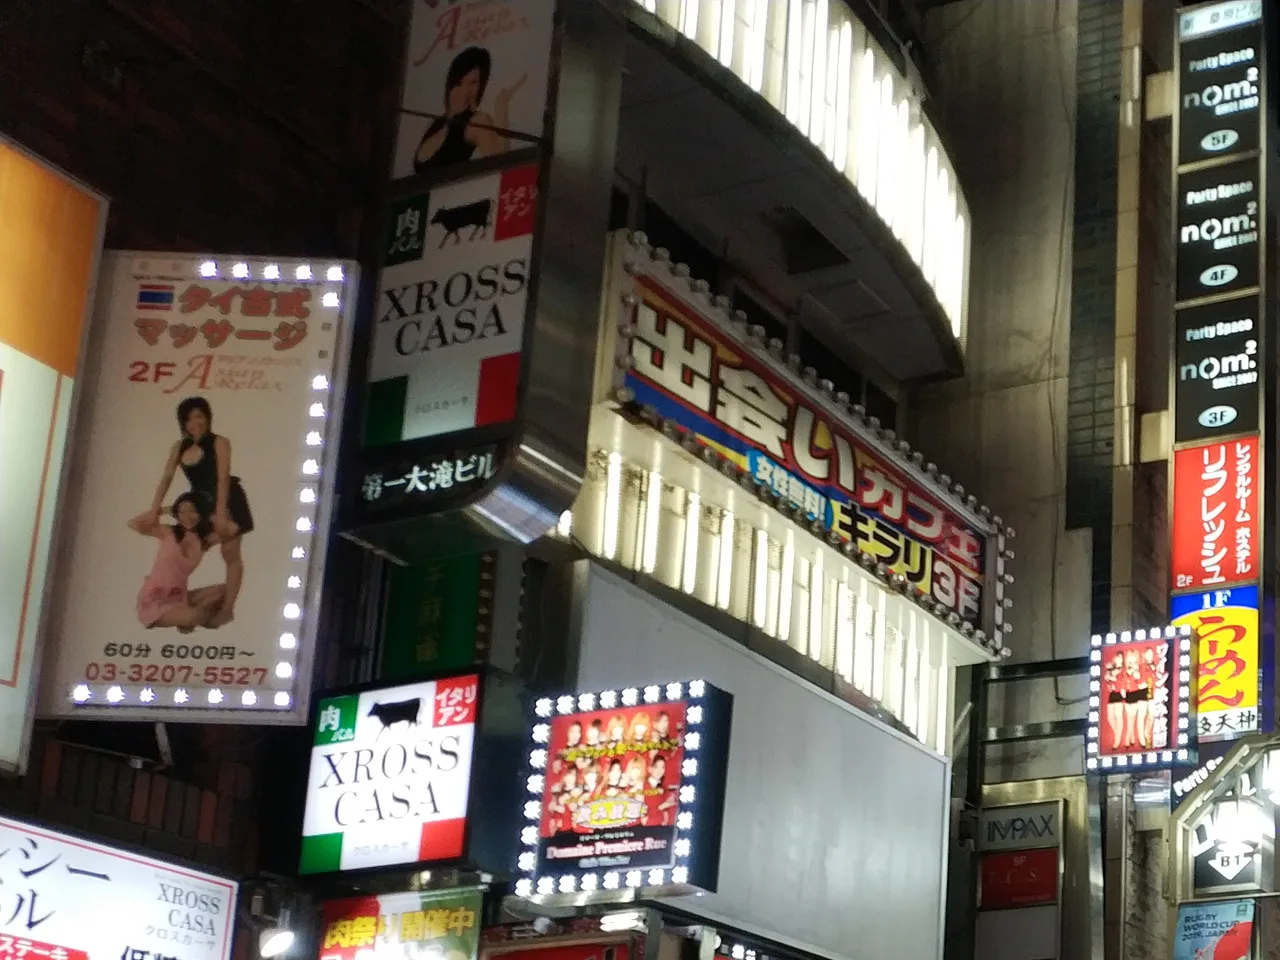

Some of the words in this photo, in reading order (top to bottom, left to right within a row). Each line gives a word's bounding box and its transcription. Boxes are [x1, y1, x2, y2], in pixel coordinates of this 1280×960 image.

[1210, 268, 1227, 282] 4F
[379, 258, 526, 324] XROSS
[133, 317, 308, 351] マッサージ
[395, 303, 508, 357] CASA
[128, 361, 177, 383] 2F
[1209, 410, 1227, 425] 3F
[1235, 442, 1252, 522] レンタルルーム
[1202, 445, 1228, 585] リフレッシュ
[836, 502, 933, 594] キラリ
[933, 560, 983, 620] 3F
[1202, 591, 1231, 609] 1F
[104, 642, 151, 658] 60分
[85, 663, 268, 685] 03-3207-5527
[318, 705, 341, 733] 肉
[318, 736, 461, 789] XROSS
[335, 781, 442, 826] CASA
[157, 883, 223, 915] XROSS
[168, 907, 217, 937] CASA
[145, 925, 217, 951] クロスカーサ
